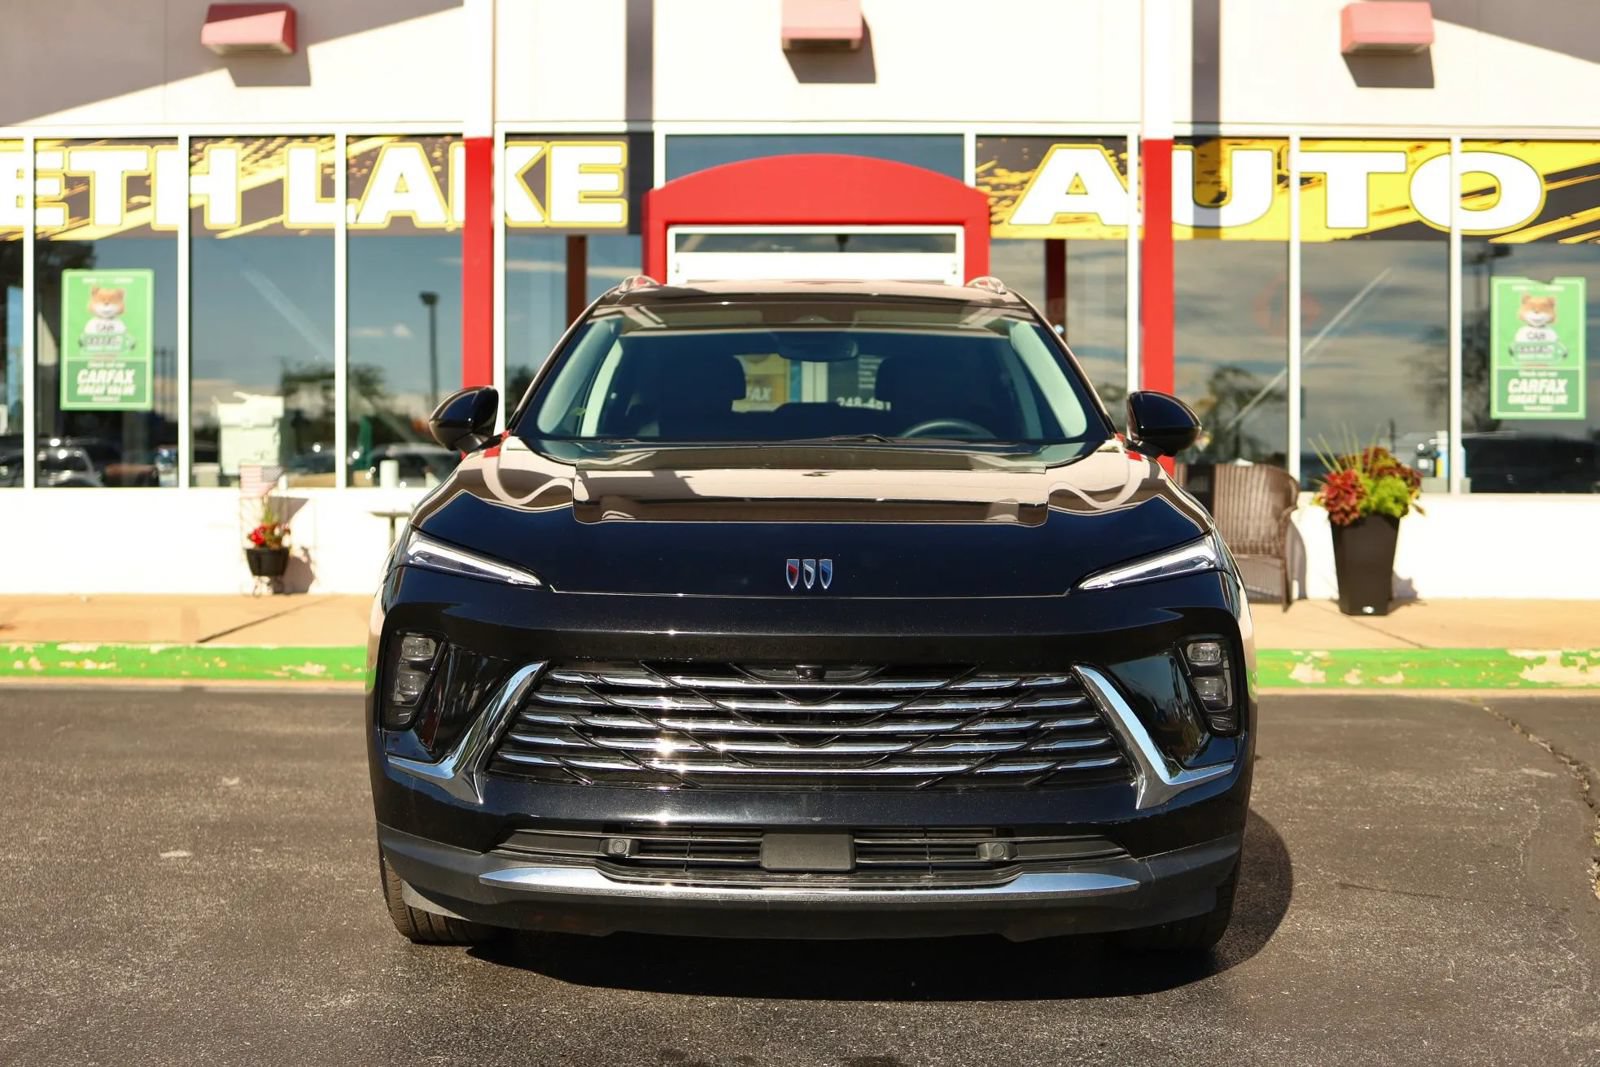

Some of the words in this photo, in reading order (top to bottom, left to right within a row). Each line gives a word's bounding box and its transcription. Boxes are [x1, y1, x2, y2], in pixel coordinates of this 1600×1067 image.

[0, 146, 241, 230] ETH
[284, 142, 628, 228] LAKE
[1007, 144, 1547, 238] AUTO
[1508, 378, 1568, 394] CARFAX
